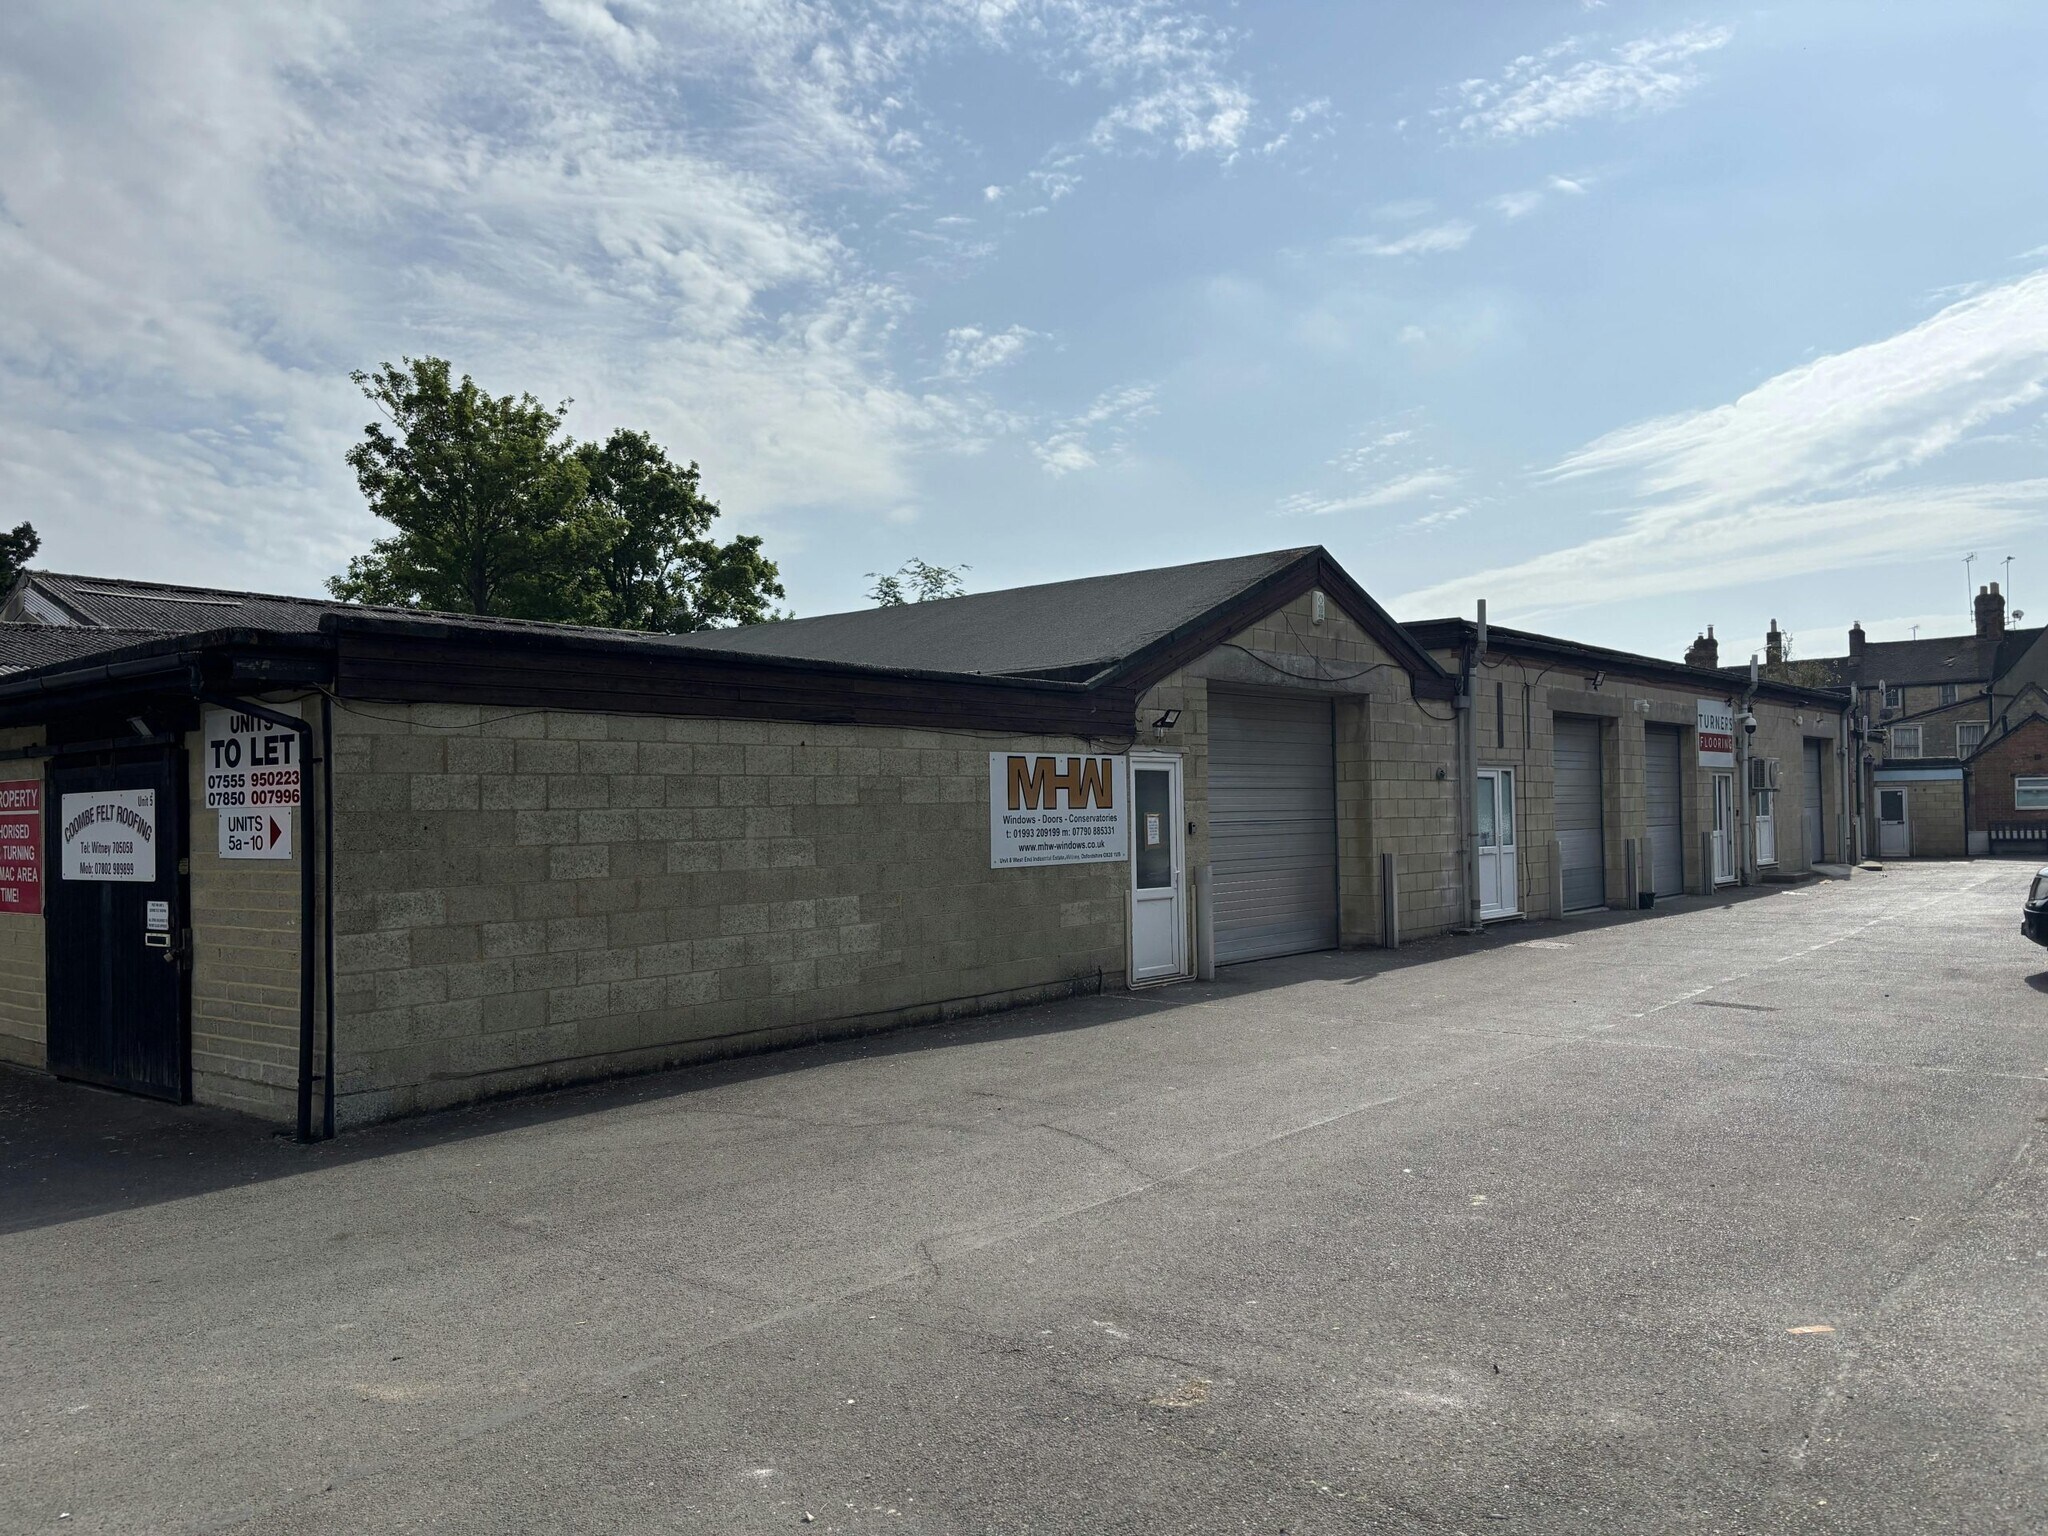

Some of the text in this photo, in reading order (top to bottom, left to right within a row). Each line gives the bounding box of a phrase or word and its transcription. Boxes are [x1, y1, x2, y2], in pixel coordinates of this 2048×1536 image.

[1698, 714, 1733, 731] TURNERS
[210, 733, 296, 768] TO LET
[1700, 736, 1732, 749] FLOORING
[208, 770, 300, 789] 07555 950223
[1007, 756, 1113, 810] MHW
[137, 795, 149, 807] Unit
[208, 789, 300, 806] 07850 007996
[64, 804, 153, 843] COOMBE FELT ROOFING
[228, 815, 263, 832] UNITS
[1002, 814, 1036, 825] Windows
[1042, 814, 1063, 824] Doors
[1068, 813, 1118, 823] Conservatories
[1013, 829, 1035, 839] 01993
[1036, 827, 1060, 838] 209199
[1072, 826, 1092, 836] 07790
[228, 835, 263, 850] 5a-10
[1018, 840, 1105, 852] www.mhw-windows.co.uk
[2, 845, 35, 861] TURNING
[16, 866, 39, 883] AREA
